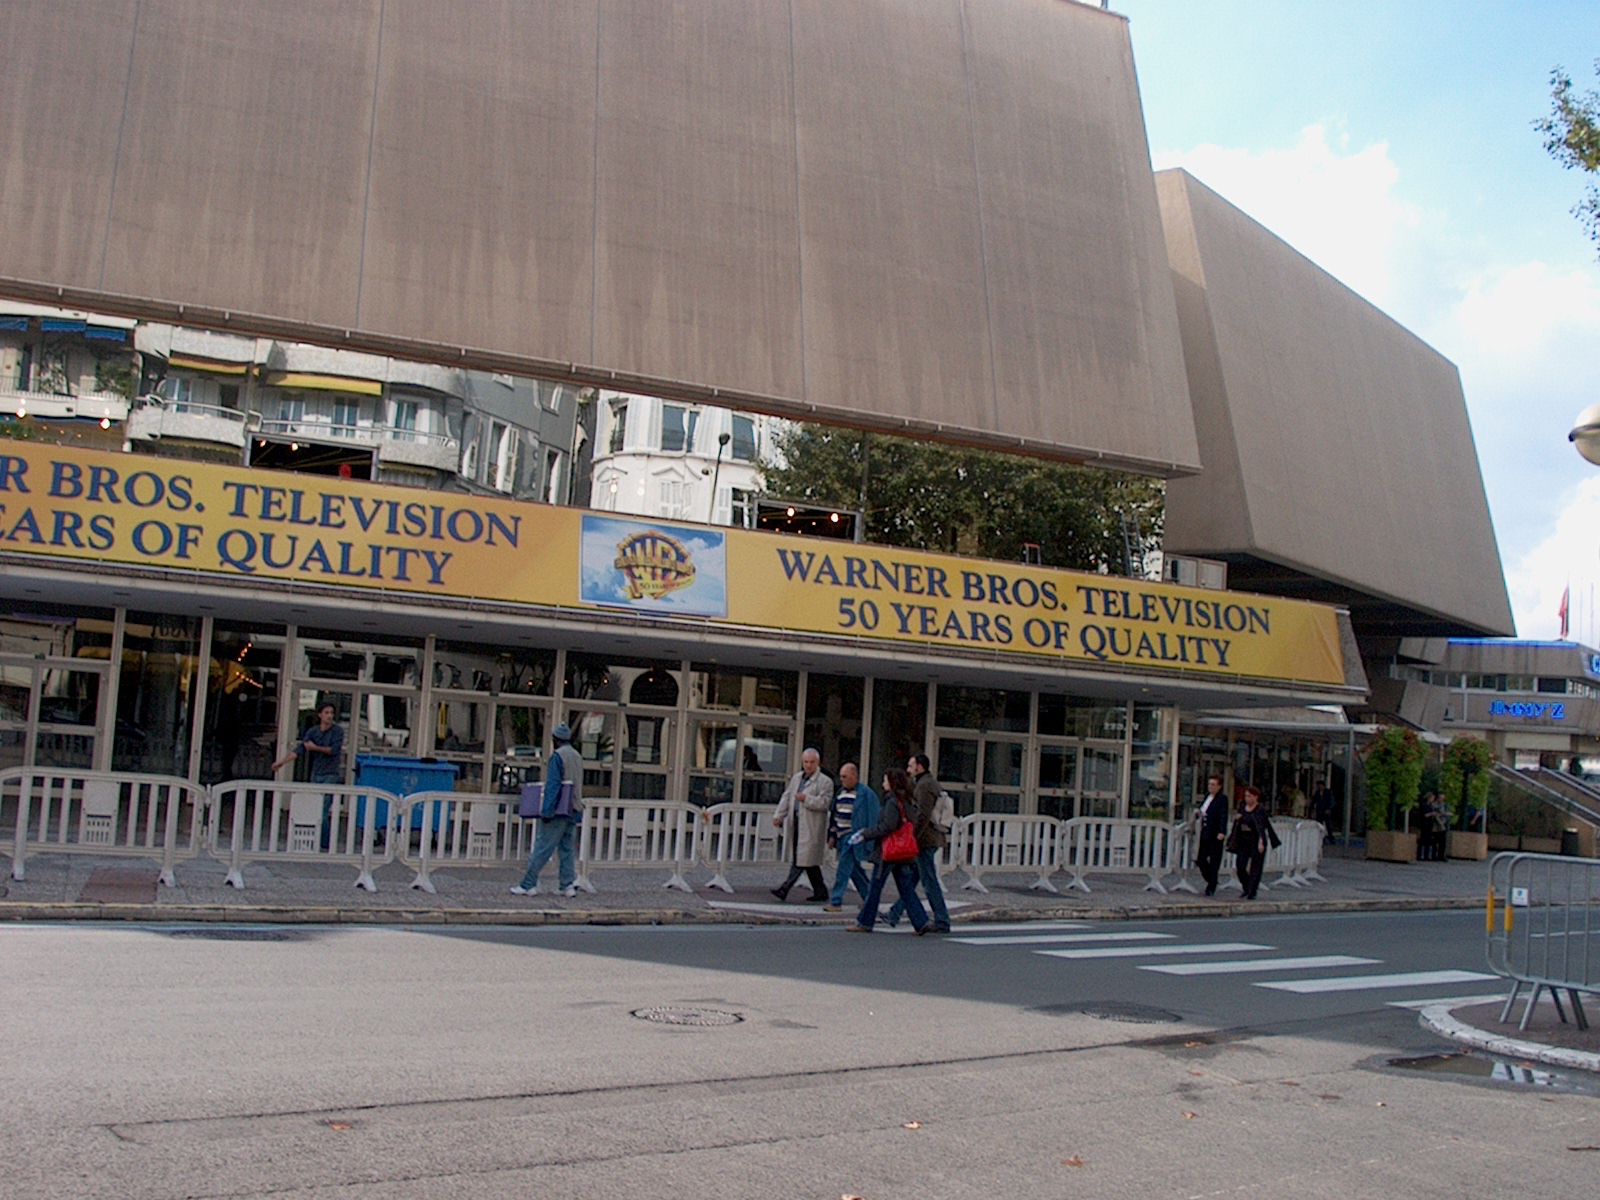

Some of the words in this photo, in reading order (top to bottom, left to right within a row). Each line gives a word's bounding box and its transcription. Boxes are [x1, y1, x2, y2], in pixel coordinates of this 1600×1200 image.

[0, 454, 31, 493] R
[47, 460, 205, 511] BROS.
[222, 480, 522, 549] TELEVISION
[0, 503, 116, 551] ARS
[130, 519, 205, 559] OF
[216, 529, 453, 585] QUALITY
[776, 548, 951, 599] WARNER
[961, 570, 1068, 612] BROS.
[1076, 585, 1271, 636] TELEVISION
[838, 597, 879, 632] 50
[890, 600, 1013, 645] YEARS
[1022, 616, 1070, 650] OF
[1078, 623, 1233, 668] QUALITY
